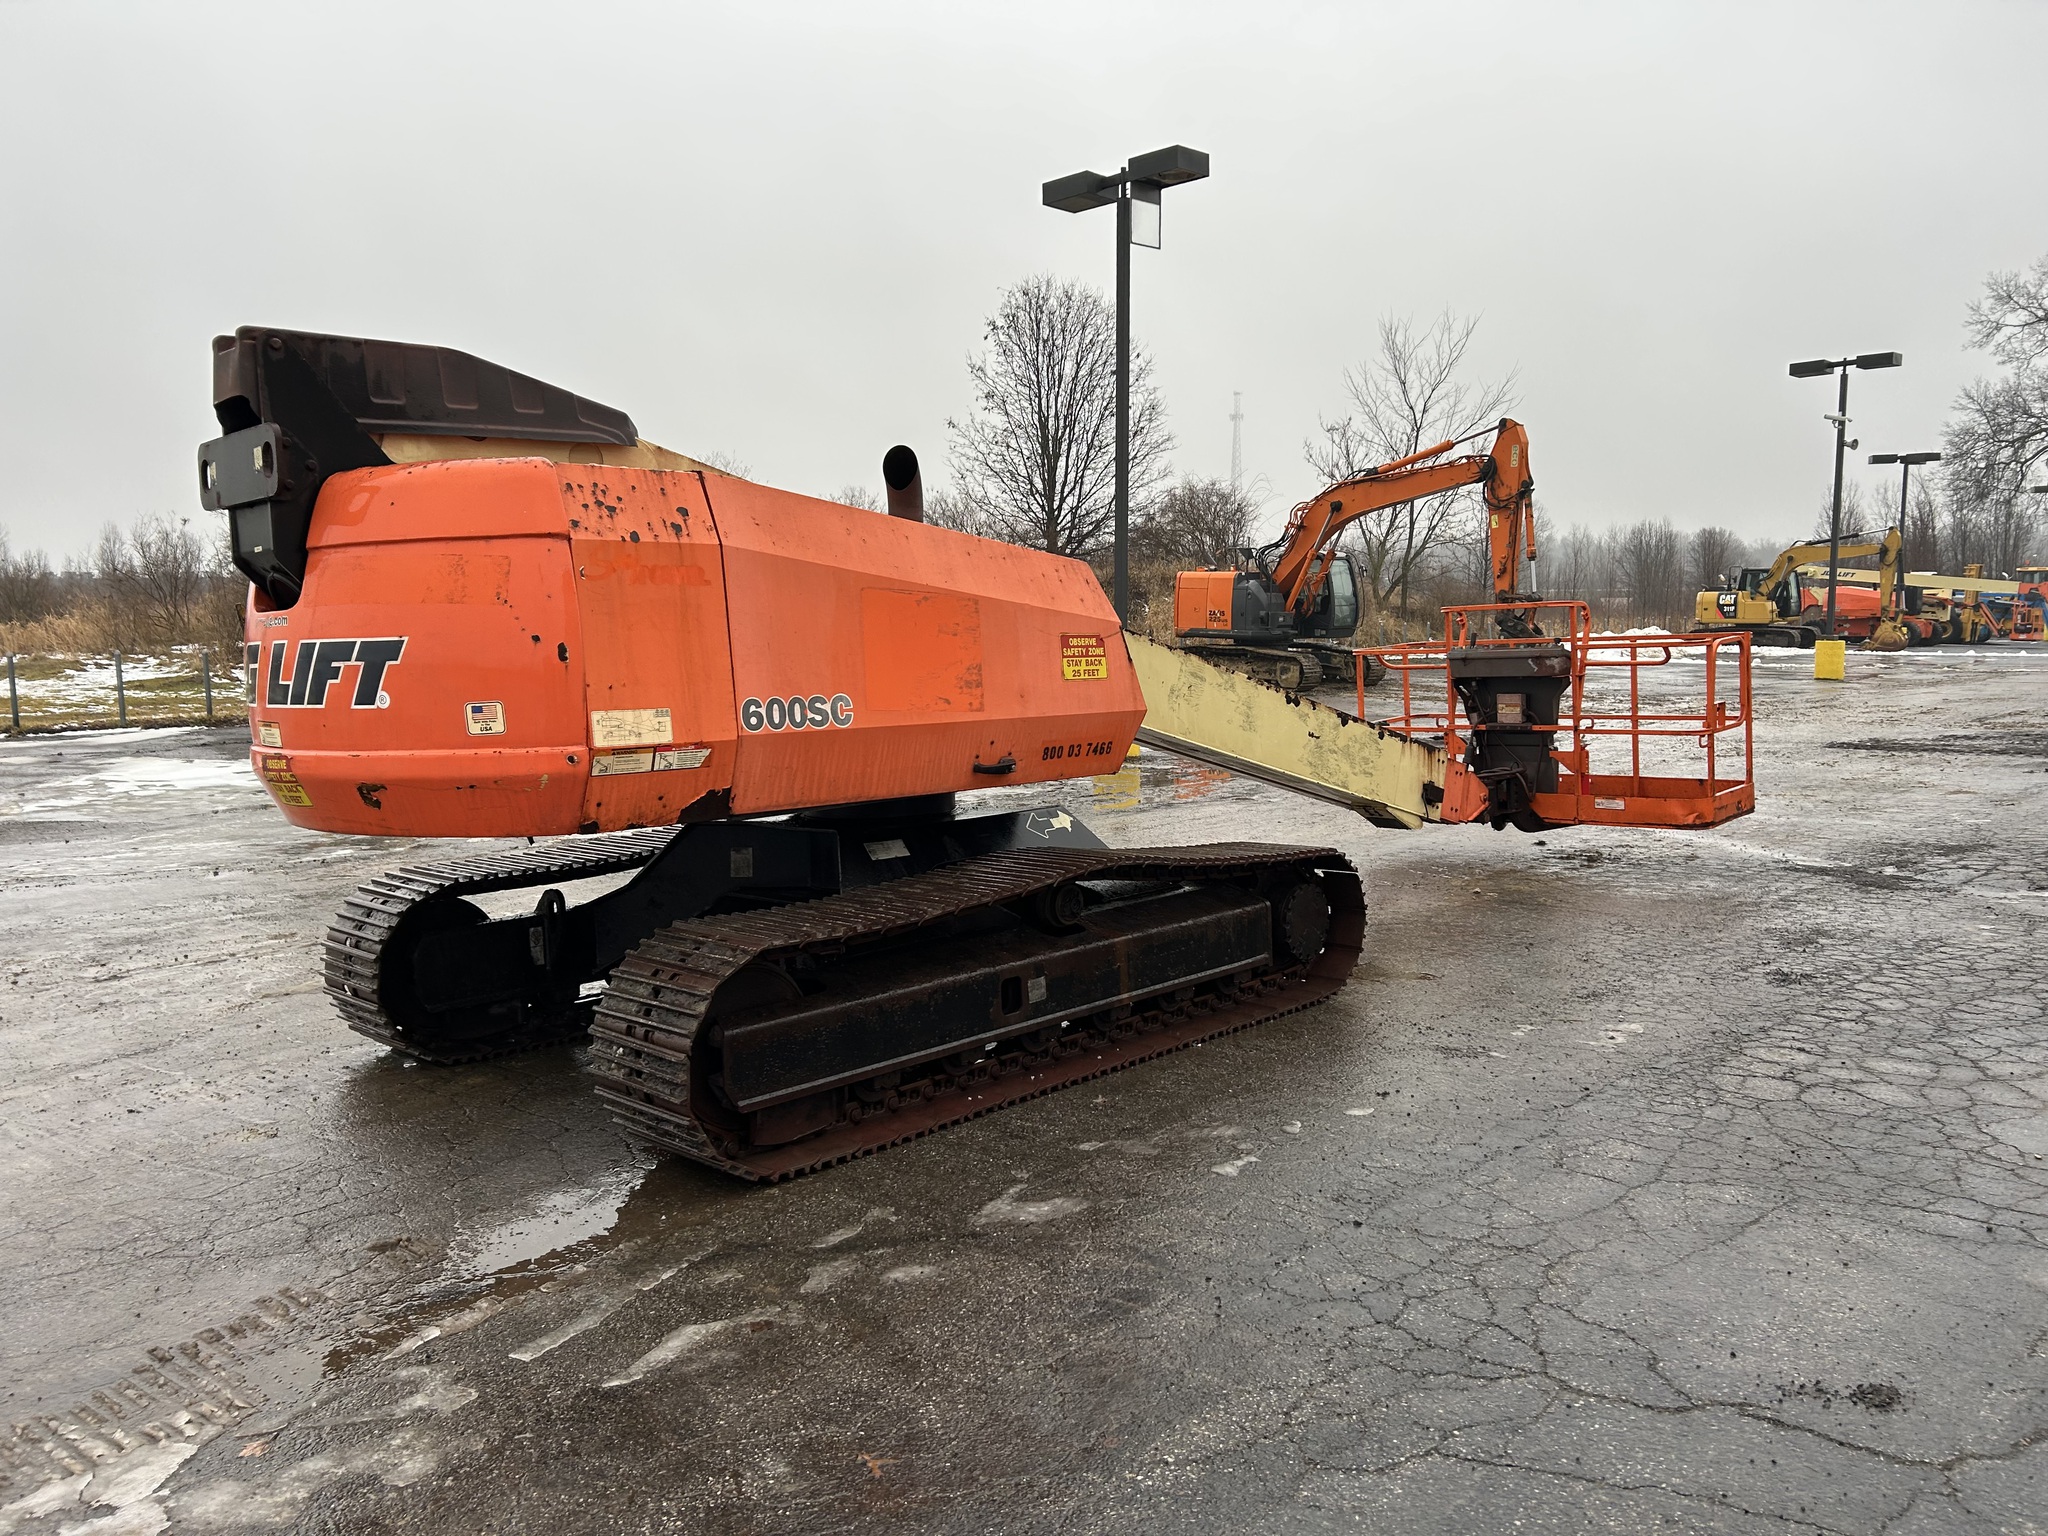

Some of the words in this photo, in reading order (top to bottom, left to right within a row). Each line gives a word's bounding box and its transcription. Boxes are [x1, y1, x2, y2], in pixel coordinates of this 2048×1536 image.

[1719, 594, 1737, 605] CAT
[1068, 637, 1097, 646] OBSERVE
[1062, 647, 1087, 656] SAFETY
[1088, 646, 1105, 656] ZONE
[1066, 659, 1082, 667] STAY
[1085, 658, 1103, 667] BACK
[266, 636, 409, 710] LIFT
[1072, 669, 1082, 677] 25
[1083, 668, 1100, 677] FEET
[740, 693, 854, 733] 600SC
[1042, 746, 1064, 761] 800
[1067, 743, 1082, 758] 03
[1085, 740, 1113, 757] 7466
